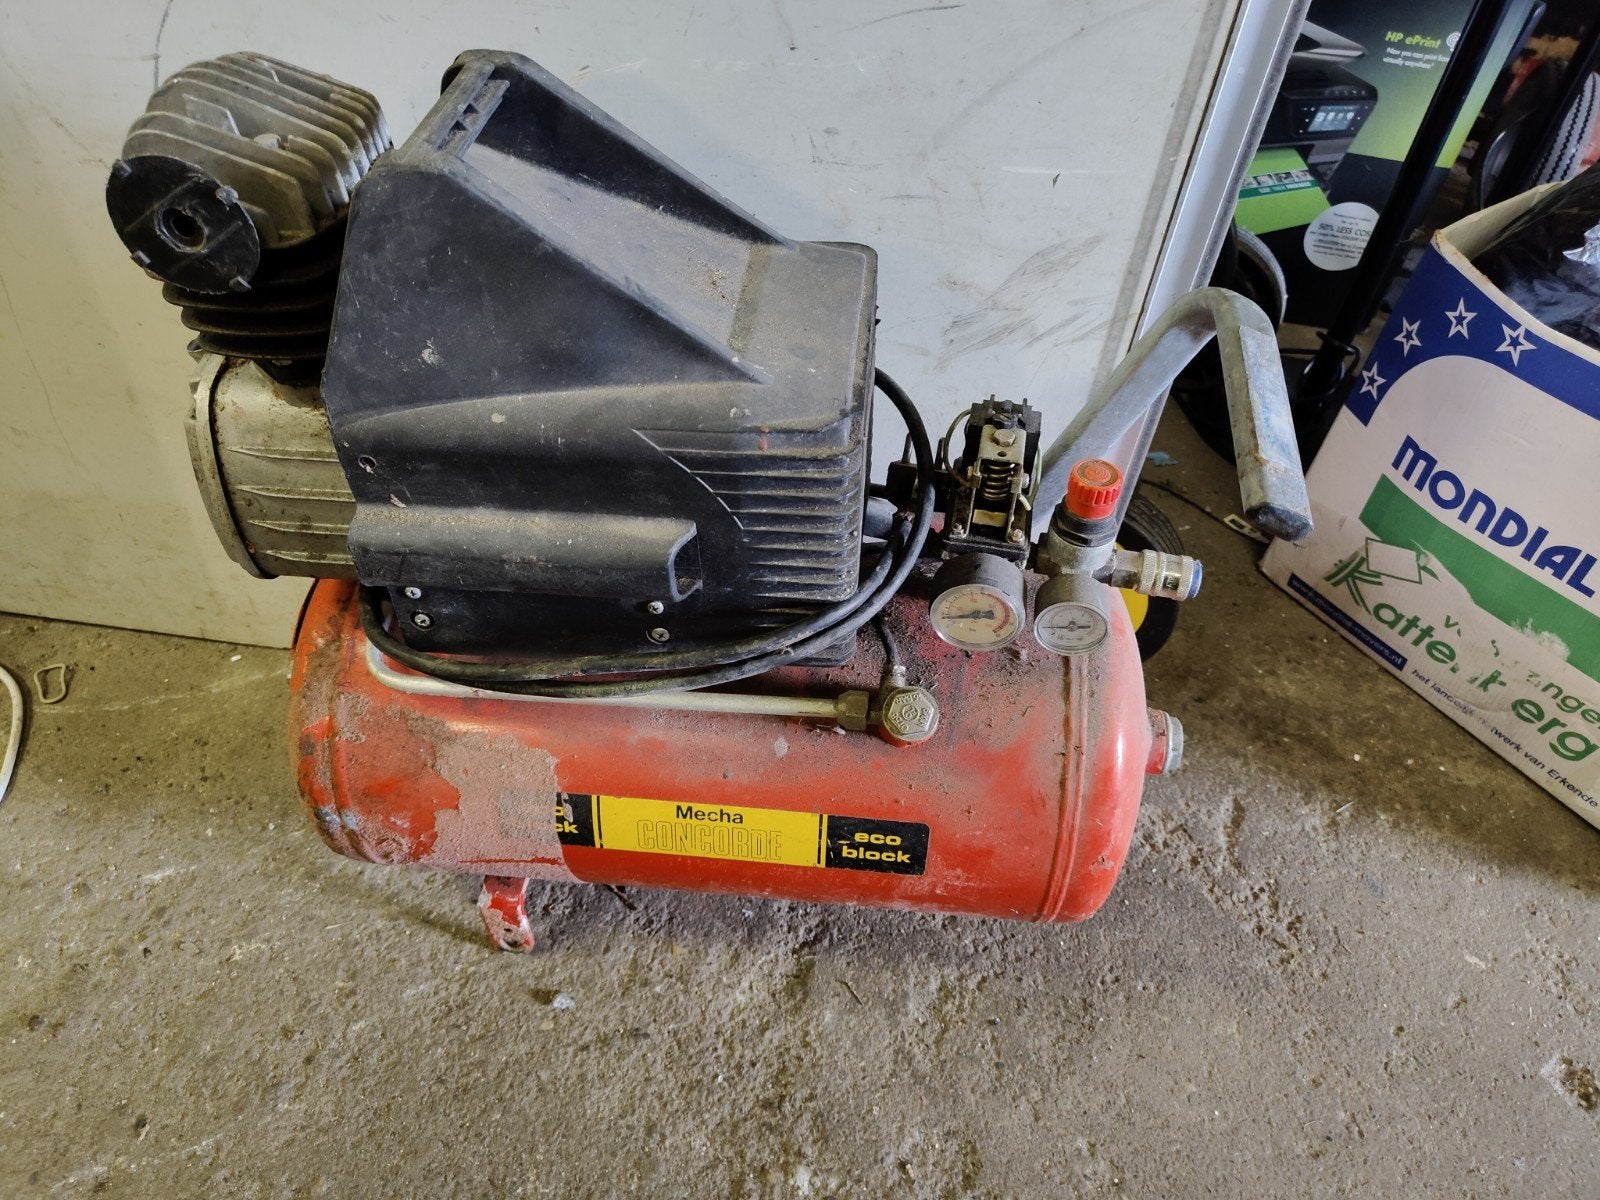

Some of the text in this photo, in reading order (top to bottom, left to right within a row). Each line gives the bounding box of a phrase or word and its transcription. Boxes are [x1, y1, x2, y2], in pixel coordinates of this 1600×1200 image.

[1385, 31, 1441, 49] HP ePrint
[1336, 227, 1354, 235] LESS
[1391, 434, 1598, 598] MONDIAL
[1412, 669, 1430, 684] het
[1524, 752, 1546, 769] van
[1547, 769, 1598, 807] Erkende
[676, 804, 744, 824] Mecha
[637, 820, 782, 861] CONCORDE
[854, 831, 902, 846] eco
[842, 845, 911, 864] block
